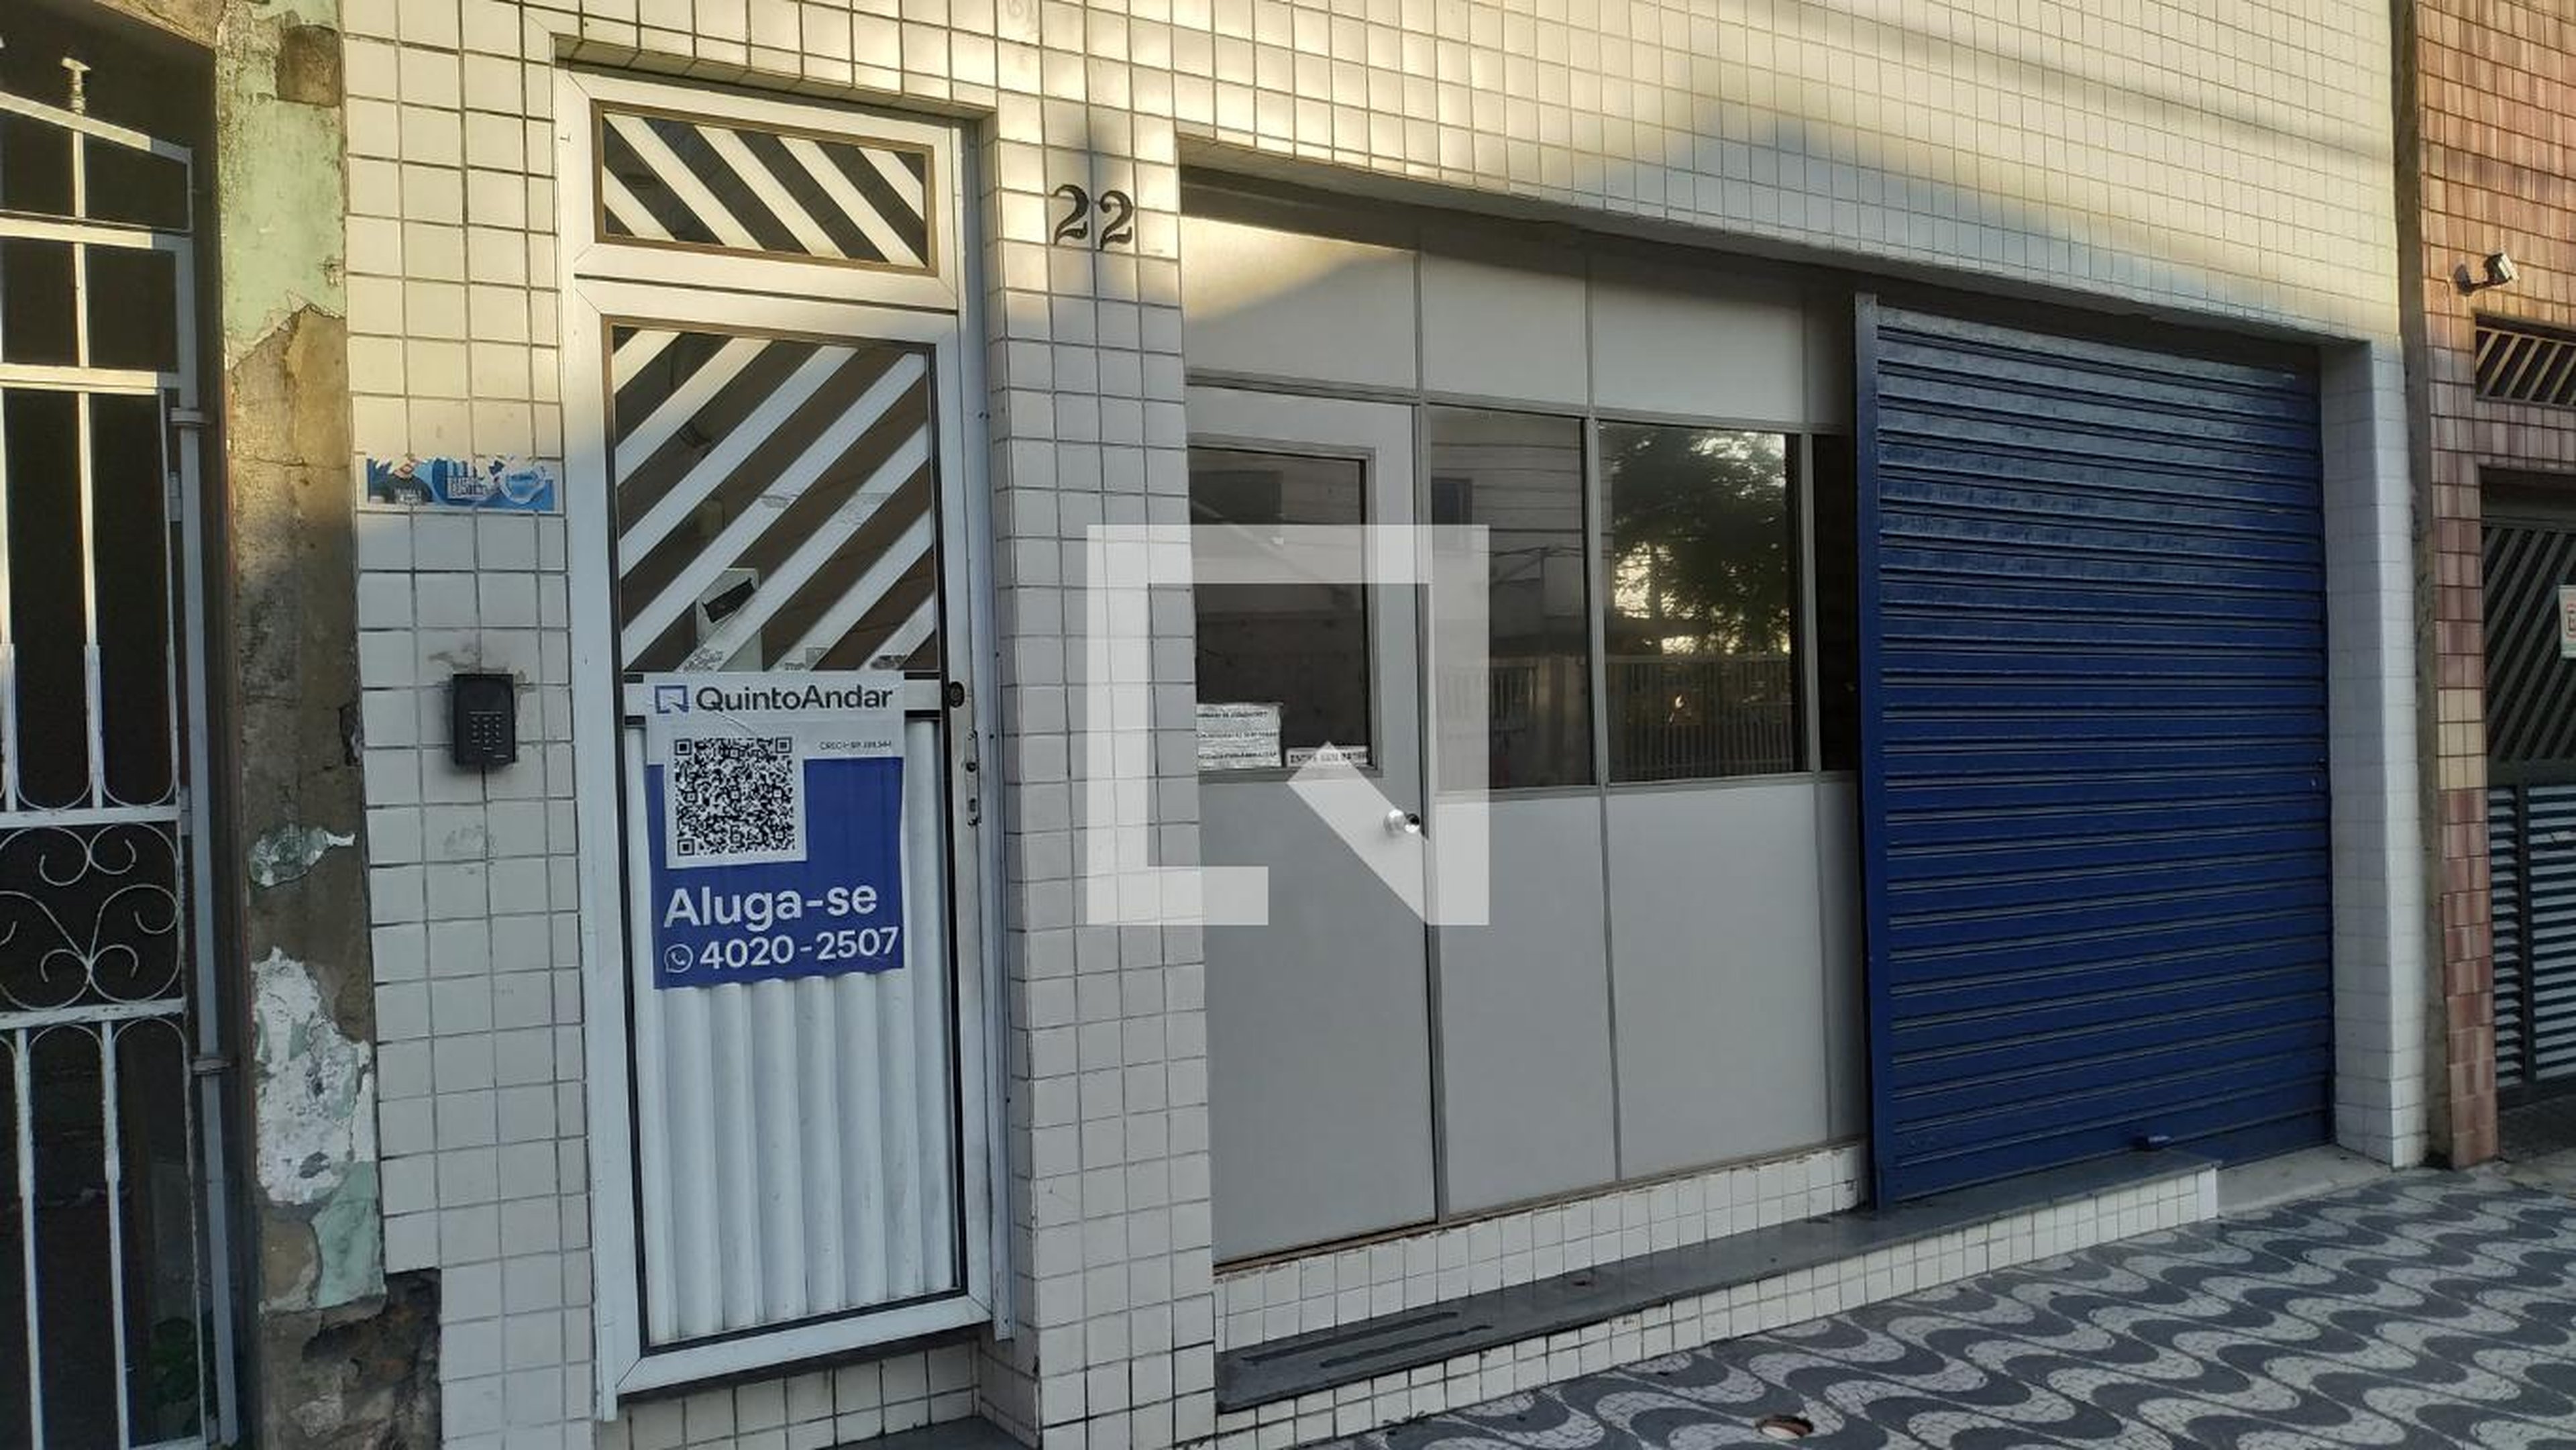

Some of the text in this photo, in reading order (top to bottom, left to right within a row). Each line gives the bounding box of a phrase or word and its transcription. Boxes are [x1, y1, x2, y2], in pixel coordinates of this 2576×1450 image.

[1051, 184, 1132, 251] 22
[696, 684, 893, 713] QuintoAndar
[663, 884, 878, 932] Aluga-se
[700, 926, 900, 970] 4020-2507
